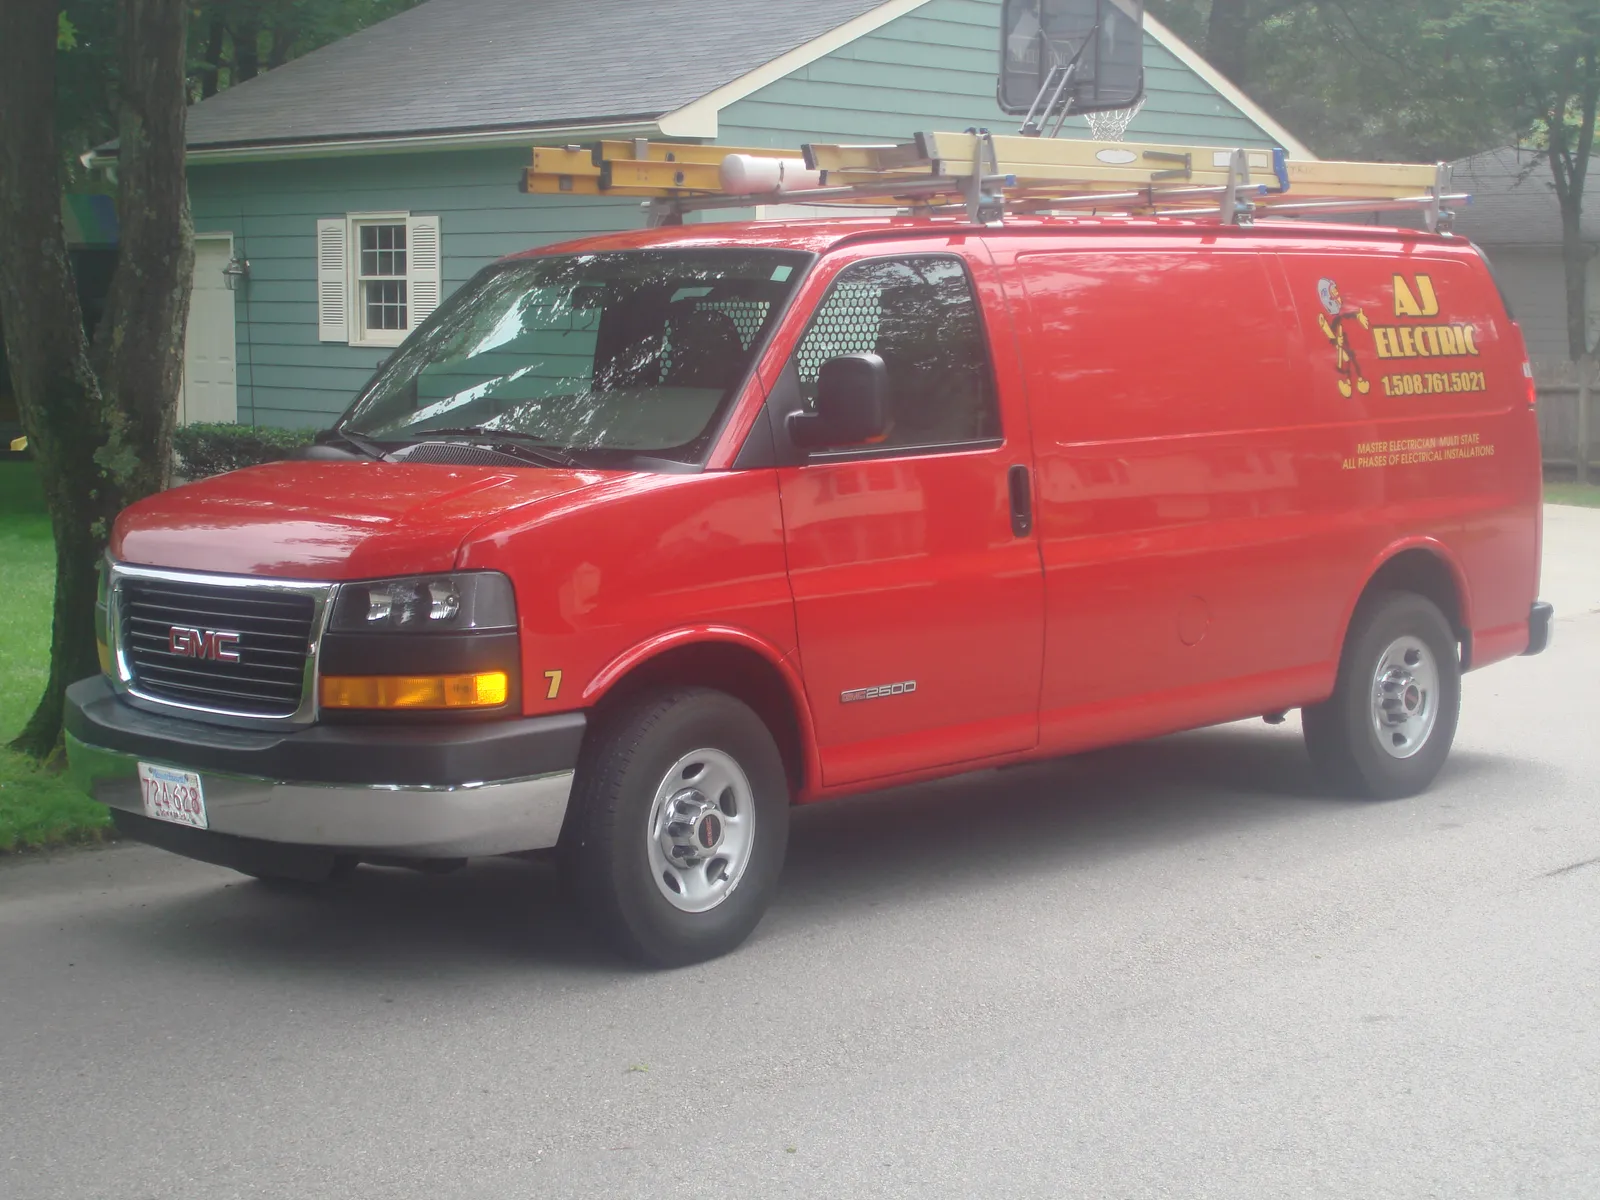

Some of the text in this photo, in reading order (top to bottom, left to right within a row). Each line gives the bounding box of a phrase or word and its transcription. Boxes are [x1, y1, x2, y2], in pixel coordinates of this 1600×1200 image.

[1393, 273, 1439, 316] AJ
[1373, 325, 1480, 358] ELECTRIC
[1381, 372, 1487, 396] 1.508.761.5021
[1342, 444, 1495, 470] ALL PHASES OF ELECTRICAL INSTALLATIONS
[1357, 433, 1480, 454] MASTER ELECTRICIAN MULTI STATE
[169, 626, 240, 663] GMC
[543, 669, 562, 699] 7
[866, 680, 916, 699] 2500
